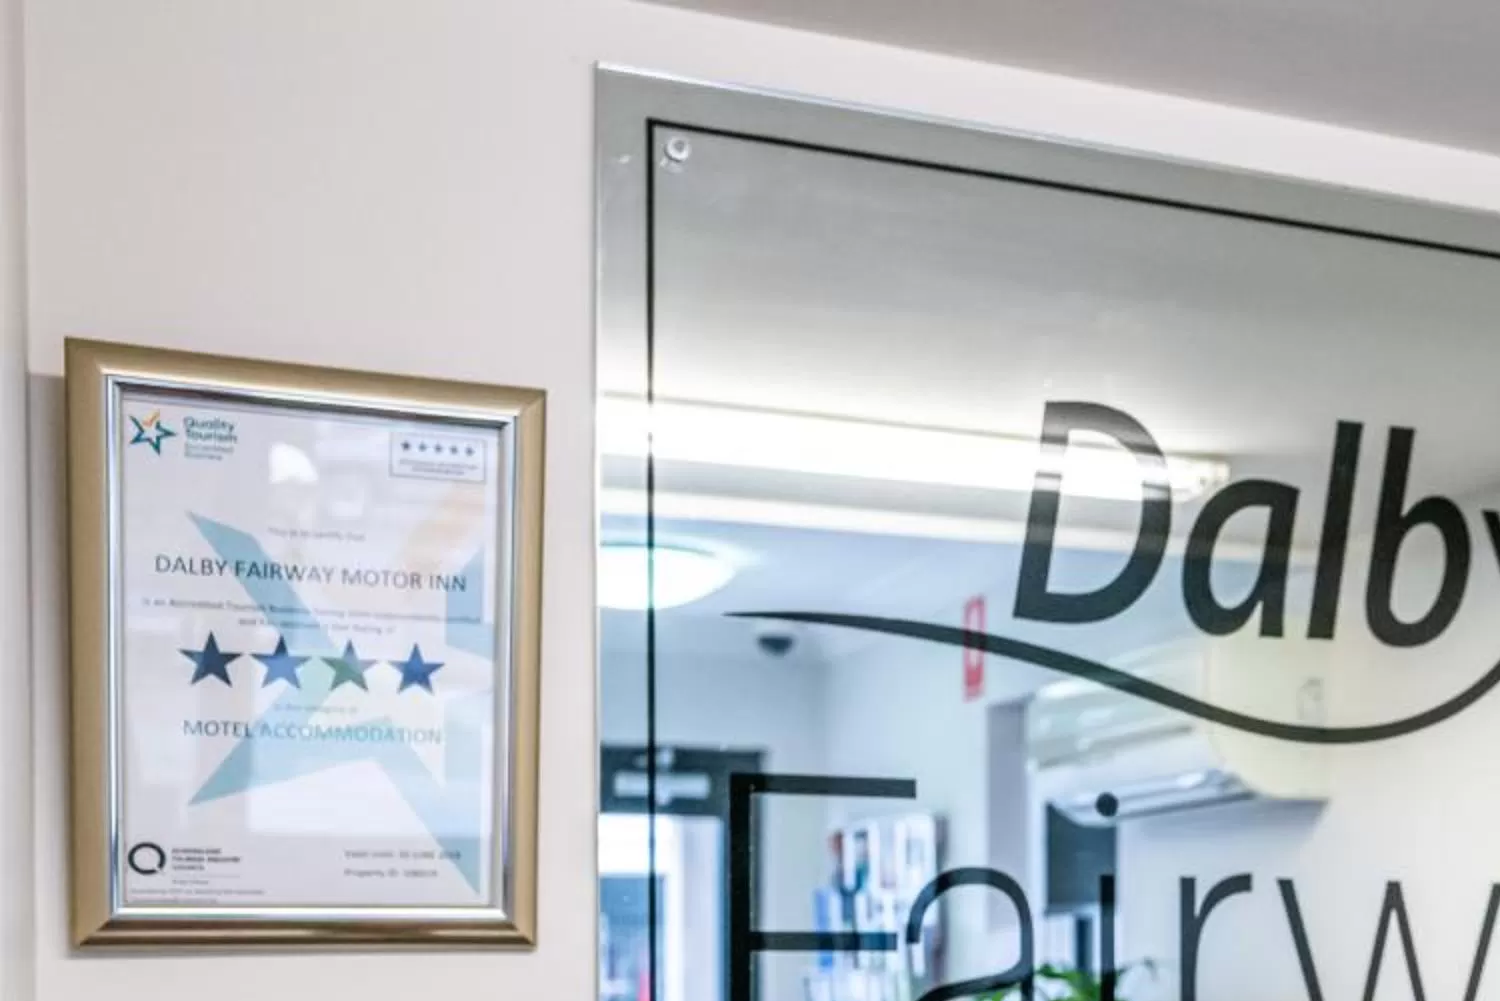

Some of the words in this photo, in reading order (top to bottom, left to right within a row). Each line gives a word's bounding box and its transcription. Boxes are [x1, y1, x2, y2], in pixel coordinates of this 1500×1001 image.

[154, 553, 228, 577] DALBY
[234, 559, 335, 584] FAIRWAY
[341, 568, 422, 590] MOTOR
[428, 574, 467, 592] INN
[183, 718, 251, 739] MOTEL
[258, 721, 442, 745] ACCOMMODATION
